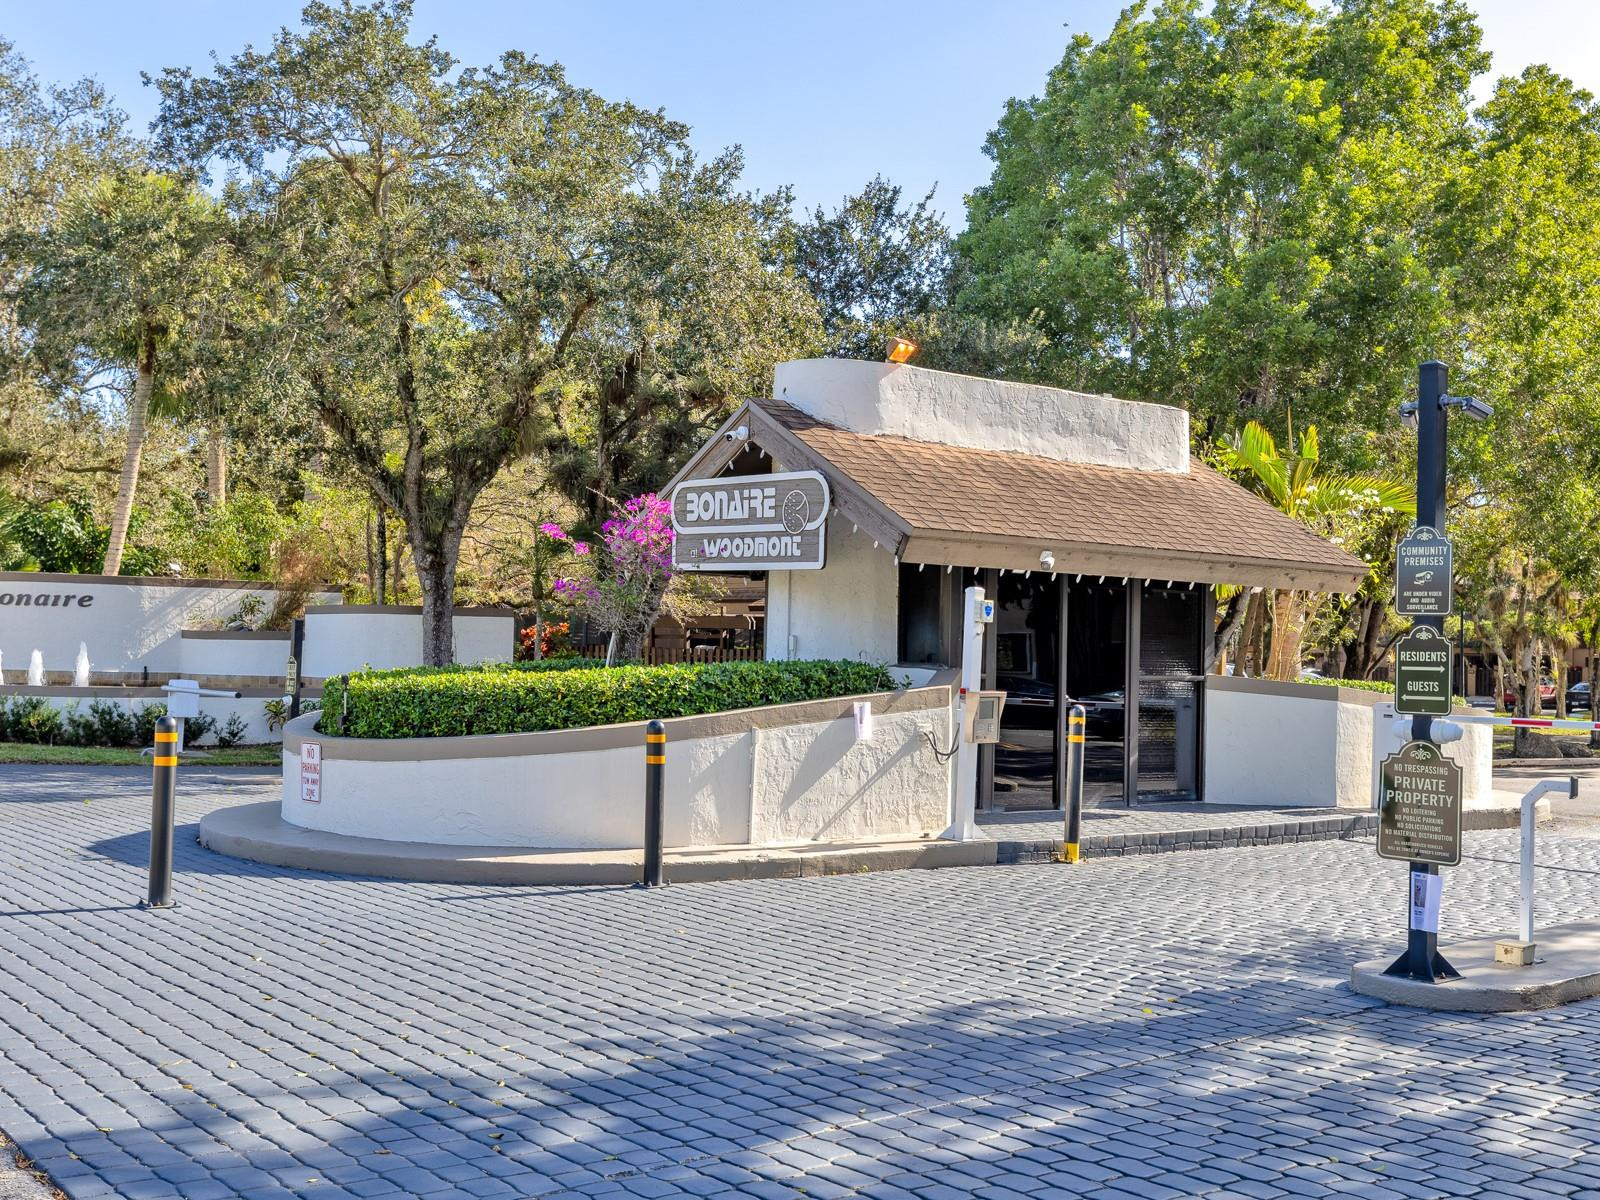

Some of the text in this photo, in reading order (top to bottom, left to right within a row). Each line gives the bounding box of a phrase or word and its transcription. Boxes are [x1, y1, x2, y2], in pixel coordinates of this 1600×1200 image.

[687, 487, 776, 522] BONAIRE
[703, 535, 801, 558] WOODMONT
[1401, 546, 1448, 556] COMMUNITY
[1404, 556, 1444, 566] PREMISES
[1400, 651, 1447, 662] RESIDENTS
[1407, 680, 1439, 692] GUESTS
[307, 748, 314, 759] NO
[302, 762, 319, 775] PARKING
[1394, 763, 1448, 776] NO TRESPASSING
[1394, 775, 1446, 792] PRIVATE
[1386, 789, 1453, 808] PROPERTY
[1410, 808, 1437, 817] LOITERING
[1422, 817, 1444, 825] PARKING
[1405, 822, 1441, 833] SOLICITATIONS
[1393, 829, 1417, 837] MATERIAL
[1418, 833, 1453, 842] DISTRIBUTION
